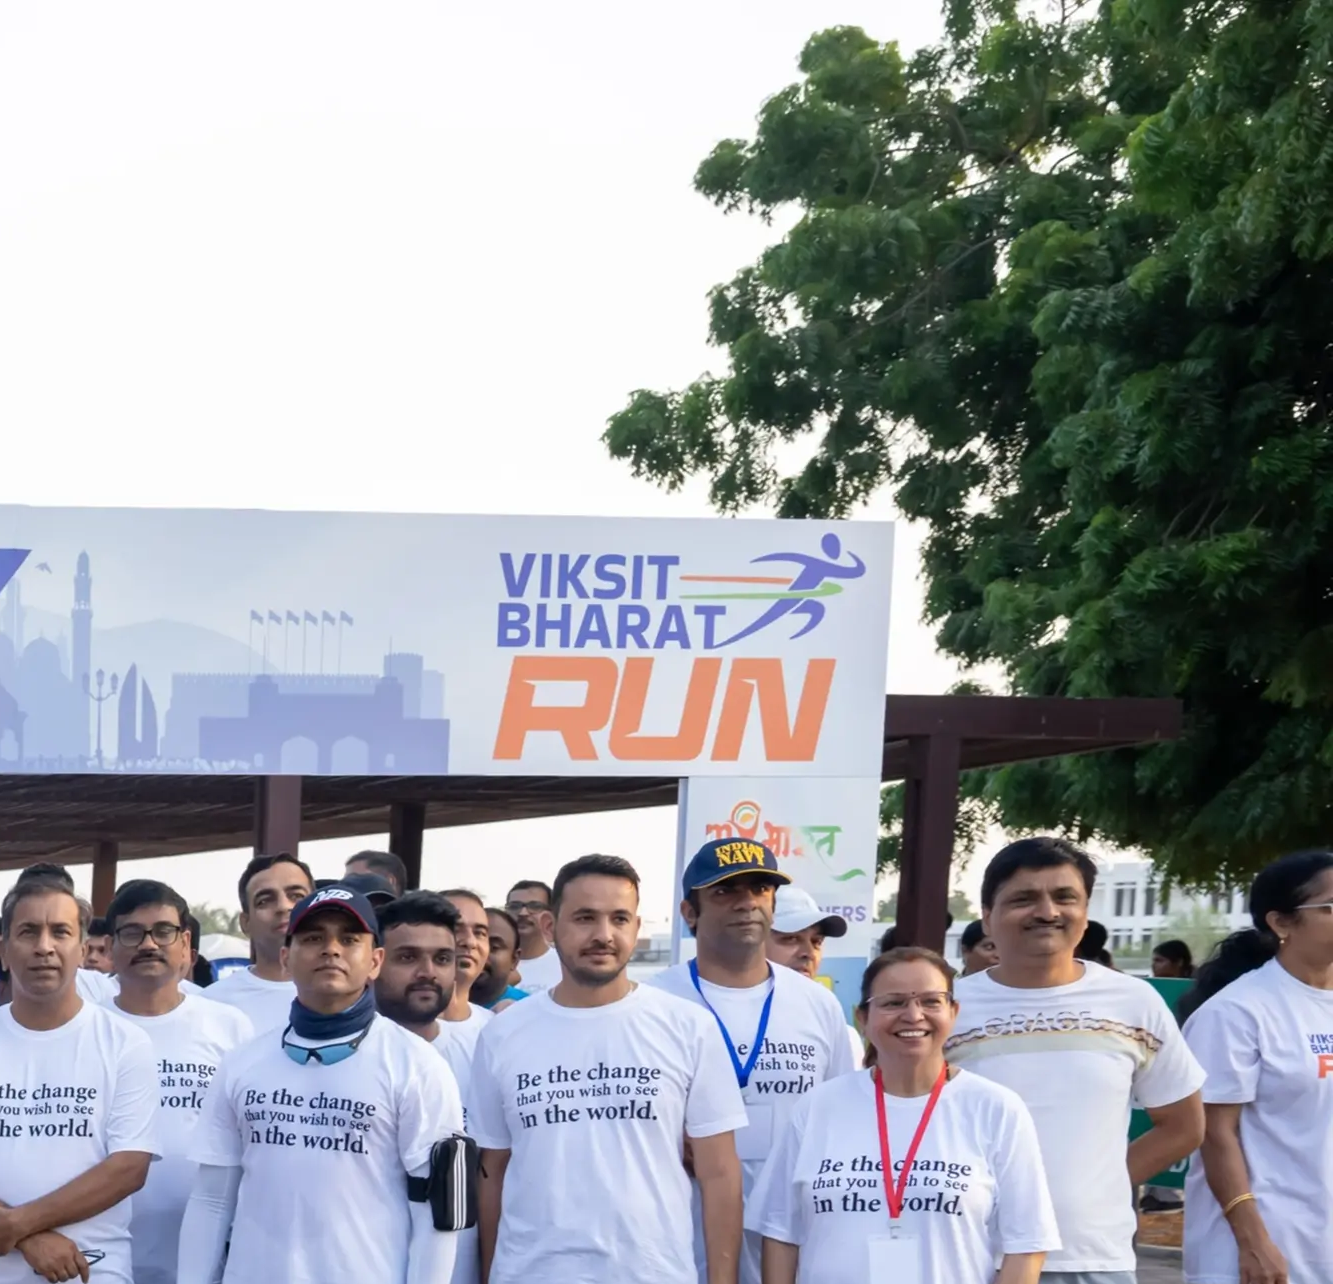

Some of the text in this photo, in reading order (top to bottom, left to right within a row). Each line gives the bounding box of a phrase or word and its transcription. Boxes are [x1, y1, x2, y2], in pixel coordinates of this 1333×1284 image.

[499, 552, 680, 600] VIKSIT
[496, 602, 729, 650] BHARAT
[492, 655, 837, 762] RUN
[516, 1062, 661, 1091] Be the change
[786, 1060, 816, 1072] to see
[32, 1083, 97, 1104] change
[180, 1077, 193, 1087] to
[244, 1088, 376, 1119] Be the change
[517, 1083, 659, 1107] that you wish to see
[24, 1102, 52, 1115] wish
[56, 1102, 70, 1114] to
[73, 1105, 94, 1115] see
[519, 1100, 658, 1129] in the world.
[29, 1118, 93, 1138] world.
[244, 1109, 371, 1132] that you wish to see
[265, 1126, 369, 1155] the world.
[818, 1156, 883, 1175] Be the
[812, 1176, 969, 1192] that you to see
[813, 1192, 881, 1214] in the
